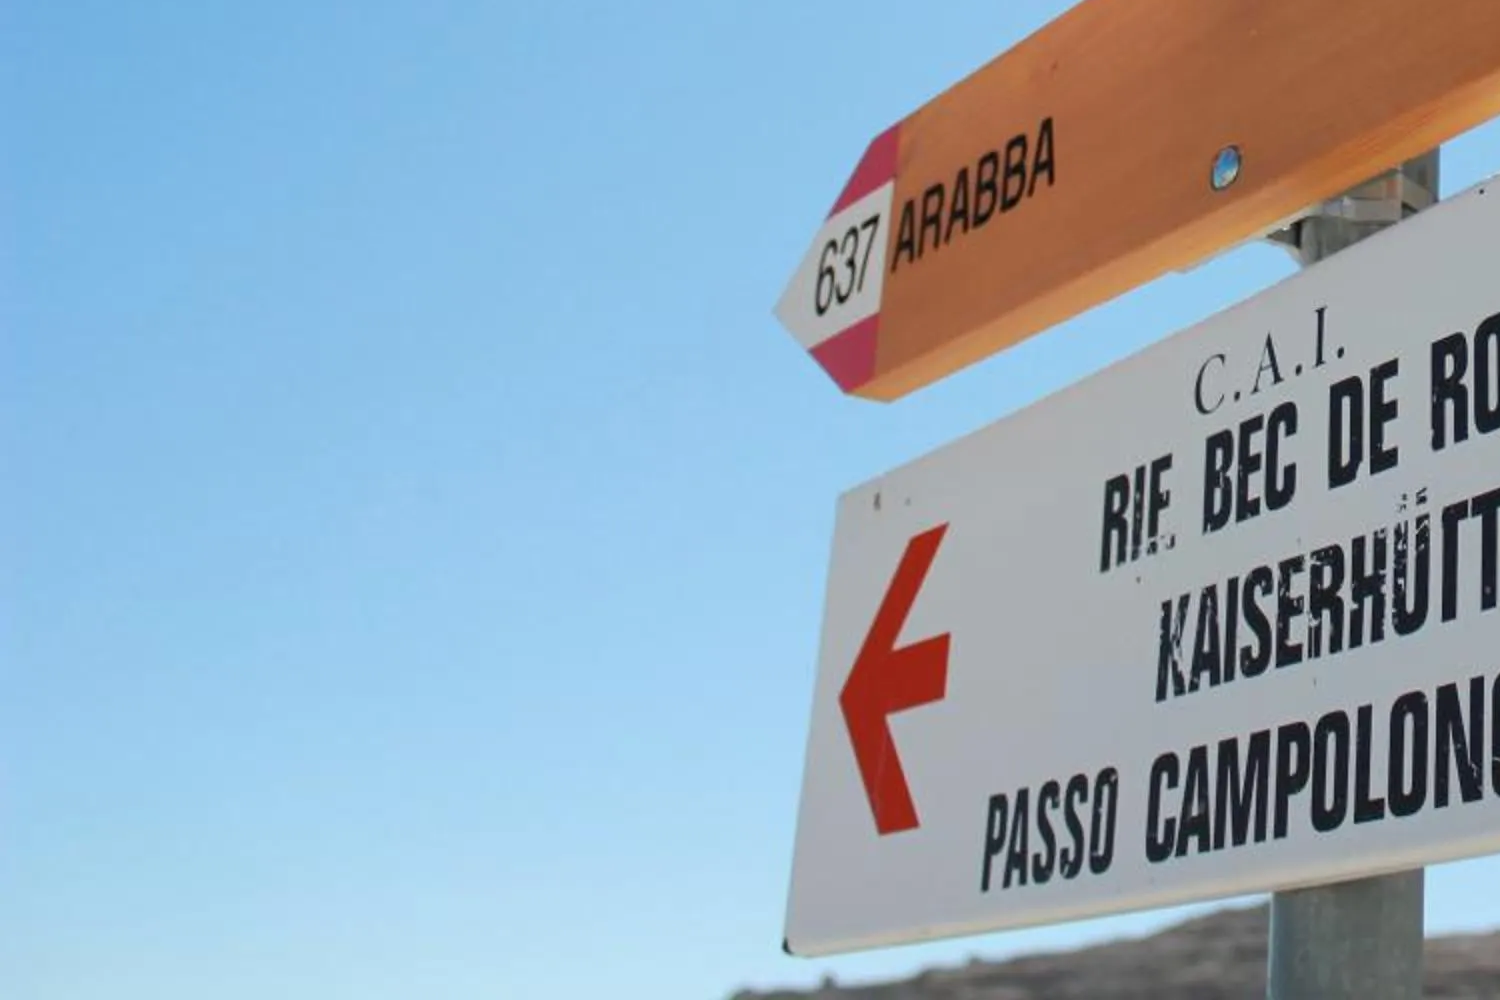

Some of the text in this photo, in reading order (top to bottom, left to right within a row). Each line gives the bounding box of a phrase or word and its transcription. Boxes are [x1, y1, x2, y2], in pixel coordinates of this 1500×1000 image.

[815, 117, 1055, 317] 637 ARABBA
[1194, 305, 1345, 415] C.A.I.
[1202, 401, 1298, 534] BEC
[1327, 357, 1399, 490] DE
[981, 766, 1119, 893] PASSO
